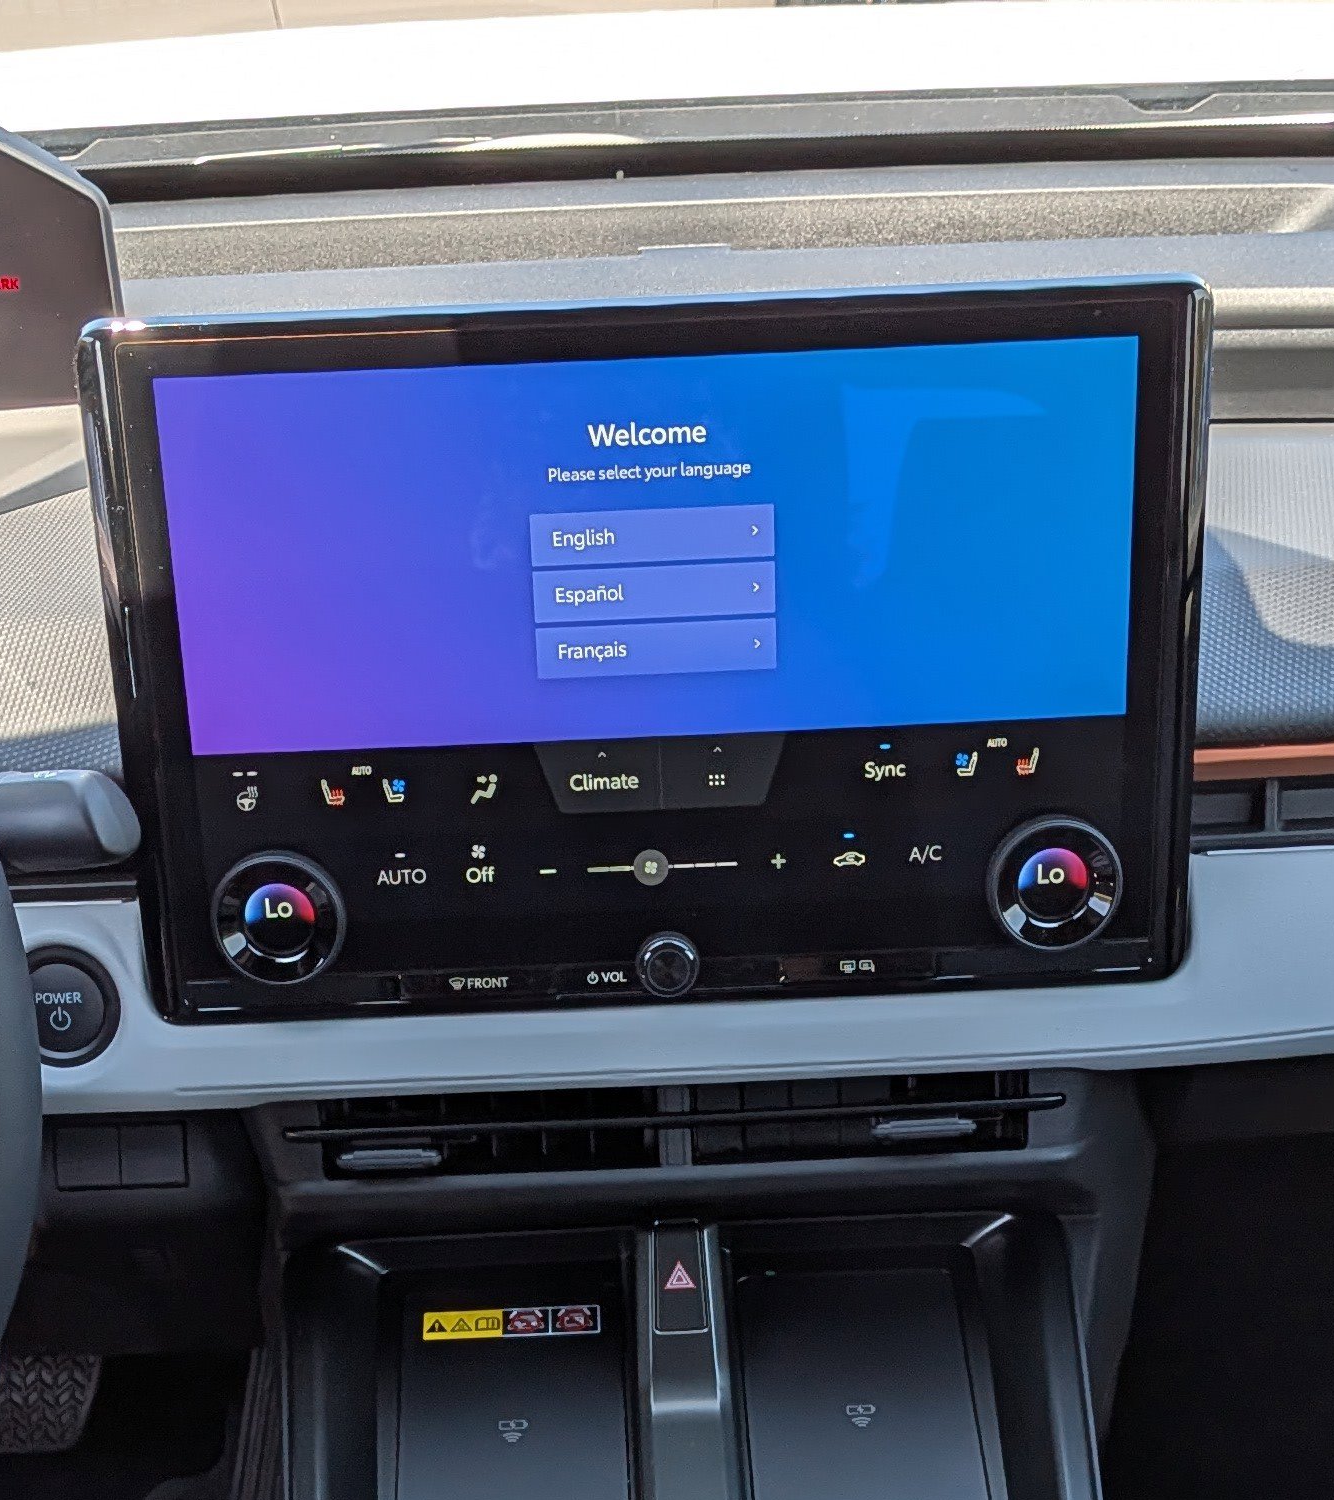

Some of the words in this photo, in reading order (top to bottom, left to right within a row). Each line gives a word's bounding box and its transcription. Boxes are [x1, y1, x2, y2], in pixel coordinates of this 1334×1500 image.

[587, 421, 707, 447] Welcome
[547, 467, 596, 483] Please
[598, 465, 642, 481] select
[644, 466, 678, 482] your
[680, 461, 751, 480] language
[552, 528, 615, 551] English
[554, 584, 624, 606] Español
[557, 641, 627, 663] Français
[987, 738, 1008, 748] AUTO
[351, 765, 372, 776] AUTO
[864, 761, 906, 781] Sync
[569, 772, 640, 793] Climate
[908, 844, 943, 865] A/C
[377, 868, 428, 886] AUTO
[465, 866, 496, 885] Off
[1036, 864, 1065, 885] Lo
[264, 897, 293, 919] Lo
[467, 976, 509, 990] FRONT
[600, 971, 628, 984] VOL
[34, 991, 83, 1006] POWER
